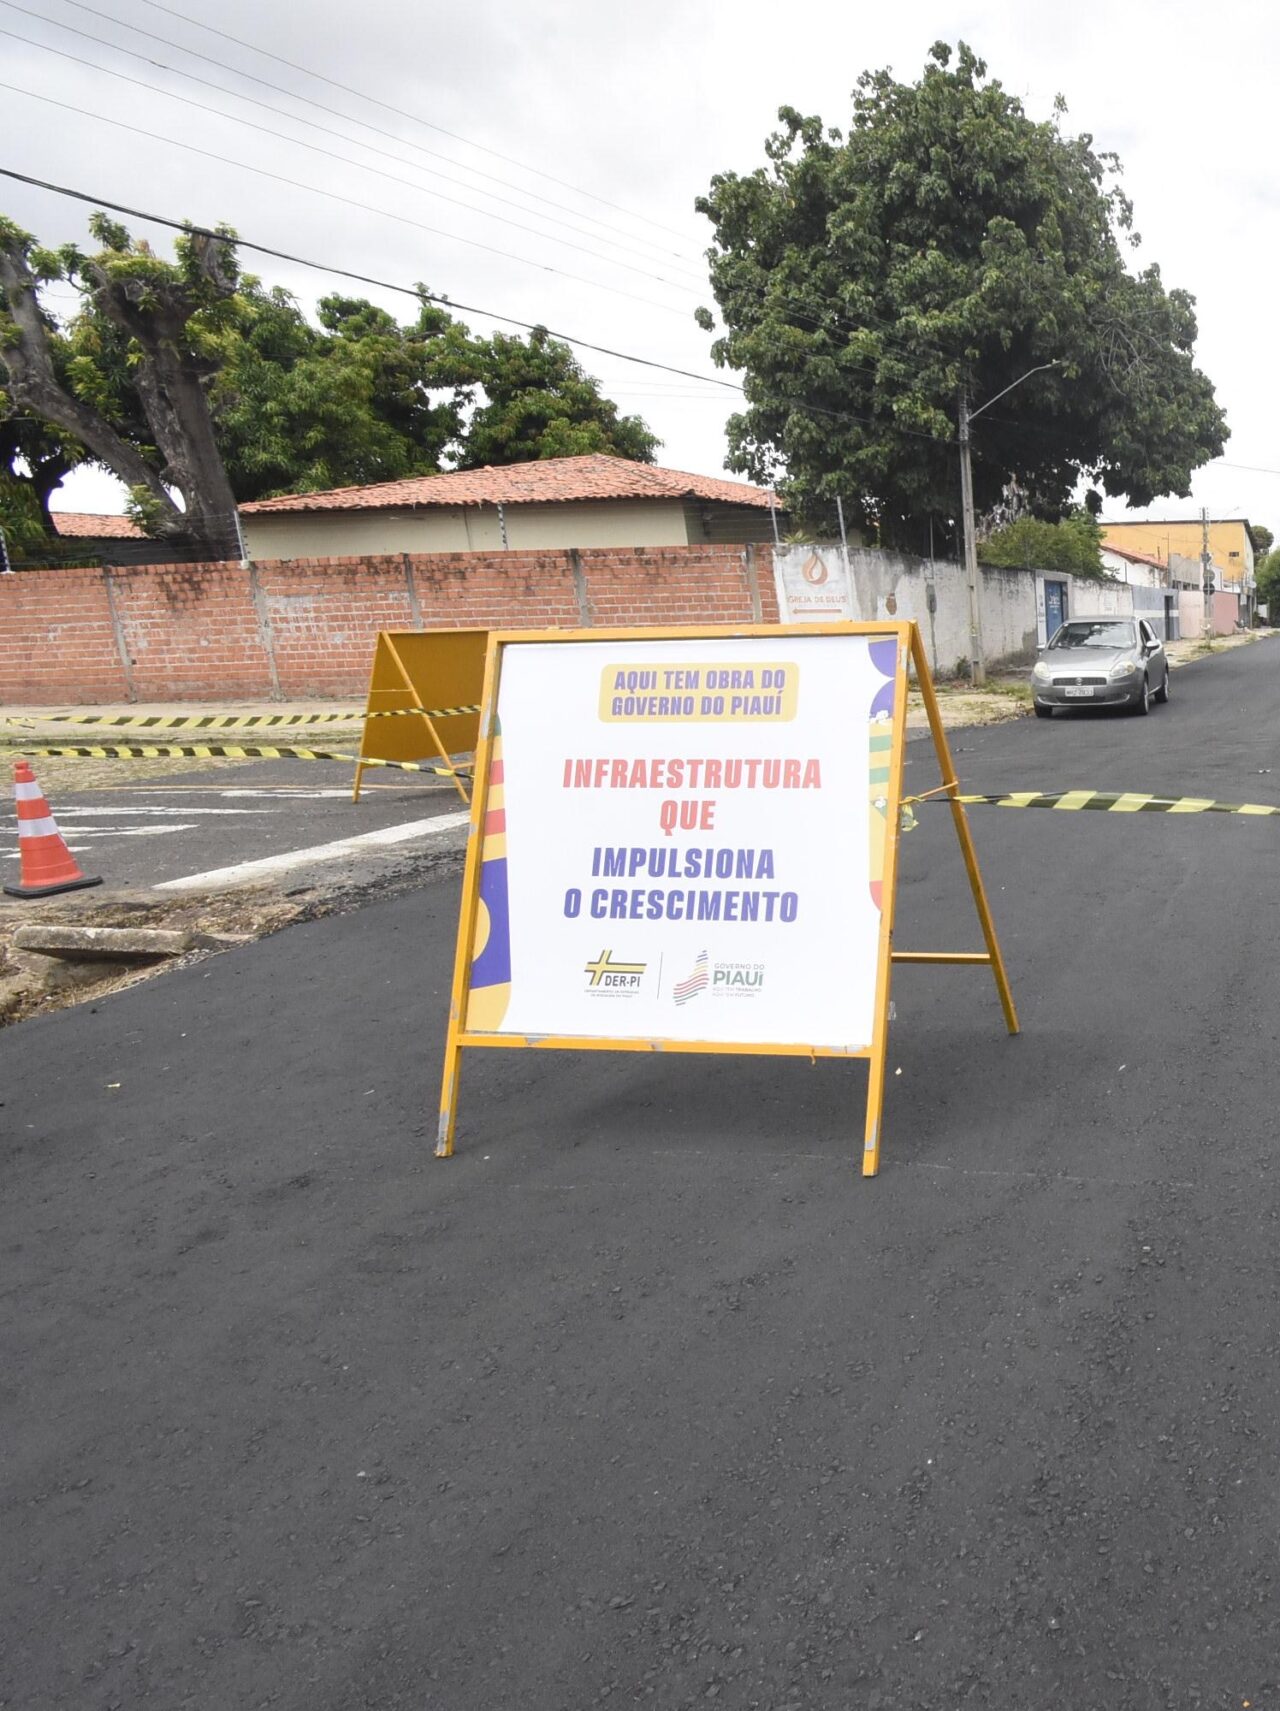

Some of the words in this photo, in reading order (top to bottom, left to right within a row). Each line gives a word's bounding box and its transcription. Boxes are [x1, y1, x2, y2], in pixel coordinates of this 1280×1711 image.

[614, 671, 657, 693] AQUI
[664, 670, 699, 690] TEM
[706, 670, 754, 690] OBRA
[761, 670, 785, 689] DO
[612, 696, 694, 716] GOVERNO
[701, 696, 724, 715] DO
[731, 690, 784, 715] PIAUÍ
[563, 759, 822, 788] INFRAESTRUTURA
[660, 800, 716, 836] QUE
[592, 848, 774, 879] IMPULSIONA
[564, 888, 581, 918] O
[590, 889, 798, 922] CRESCIMENTO
[605, 975, 641, 987] DER-PI
